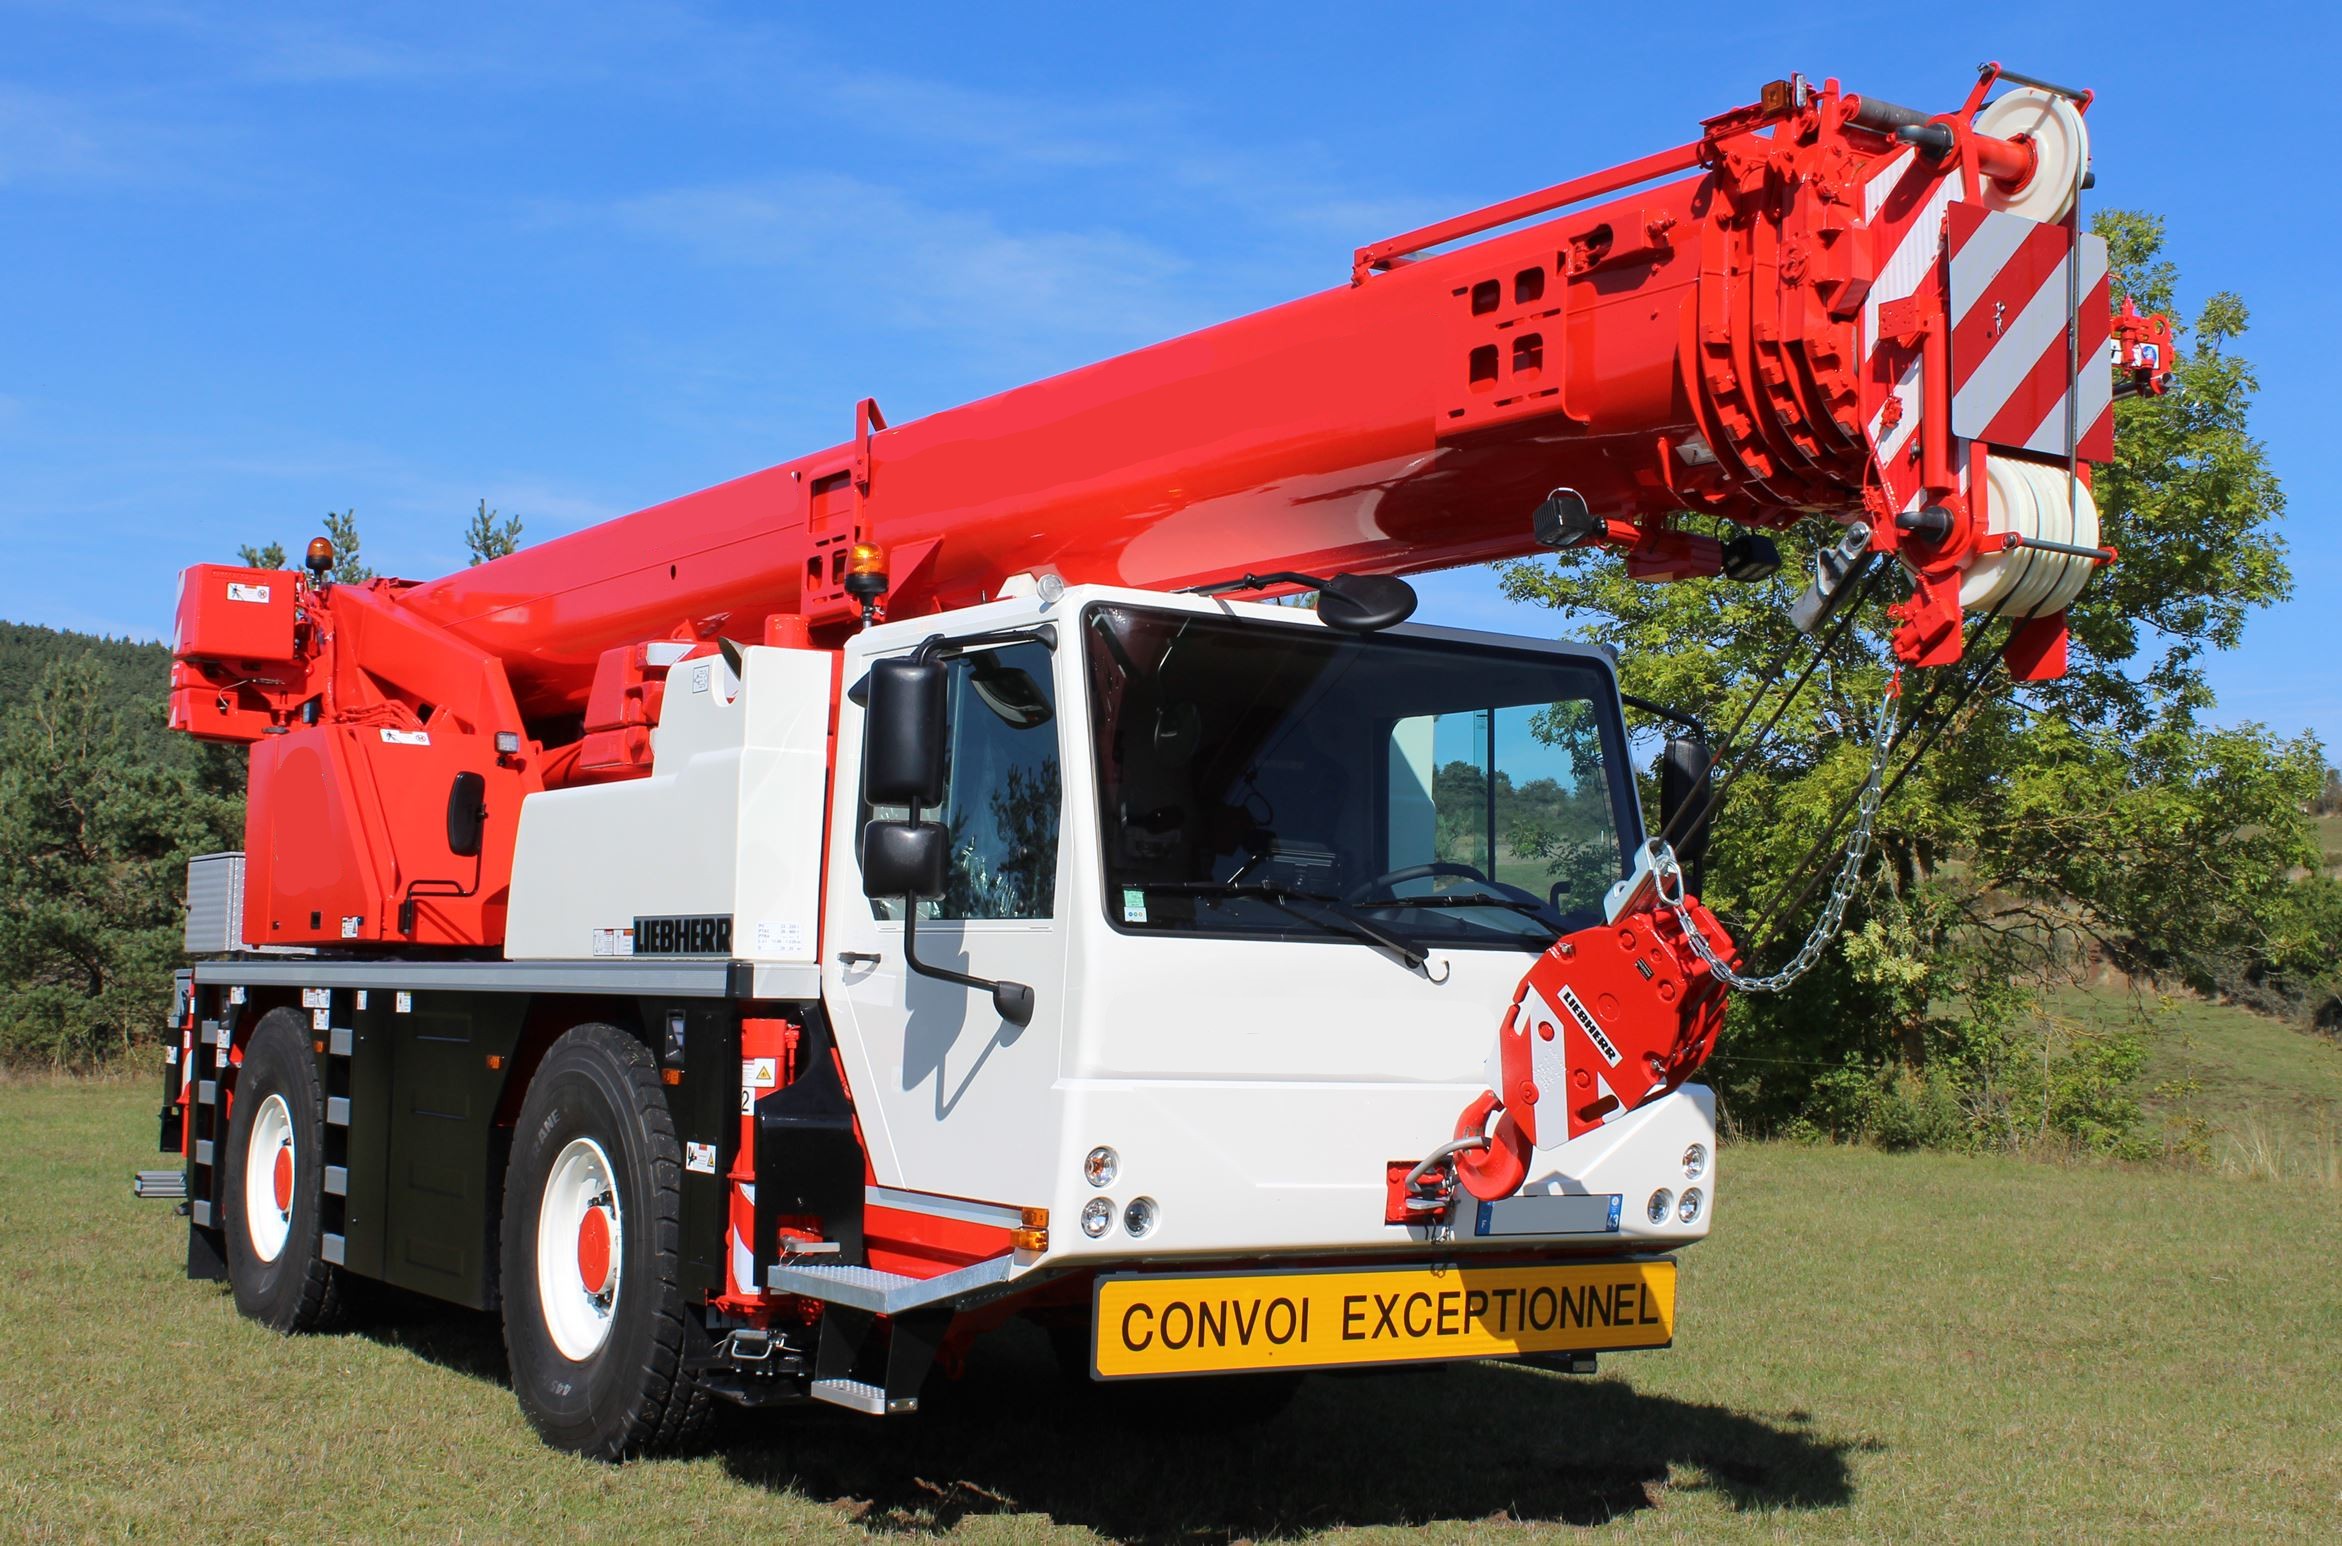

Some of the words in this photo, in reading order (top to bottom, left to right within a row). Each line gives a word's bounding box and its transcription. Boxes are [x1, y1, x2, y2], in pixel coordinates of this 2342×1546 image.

[634, 918, 733, 953] LIEBHERR
[1563, 991, 1616, 1060] LIEBHERR
[1607, 1213, 1619, 1228] 43
[1122, 1297, 1309, 1352] CONVOI
[1342, 1283, 1658, 1341] EXCEPTIONNEL
